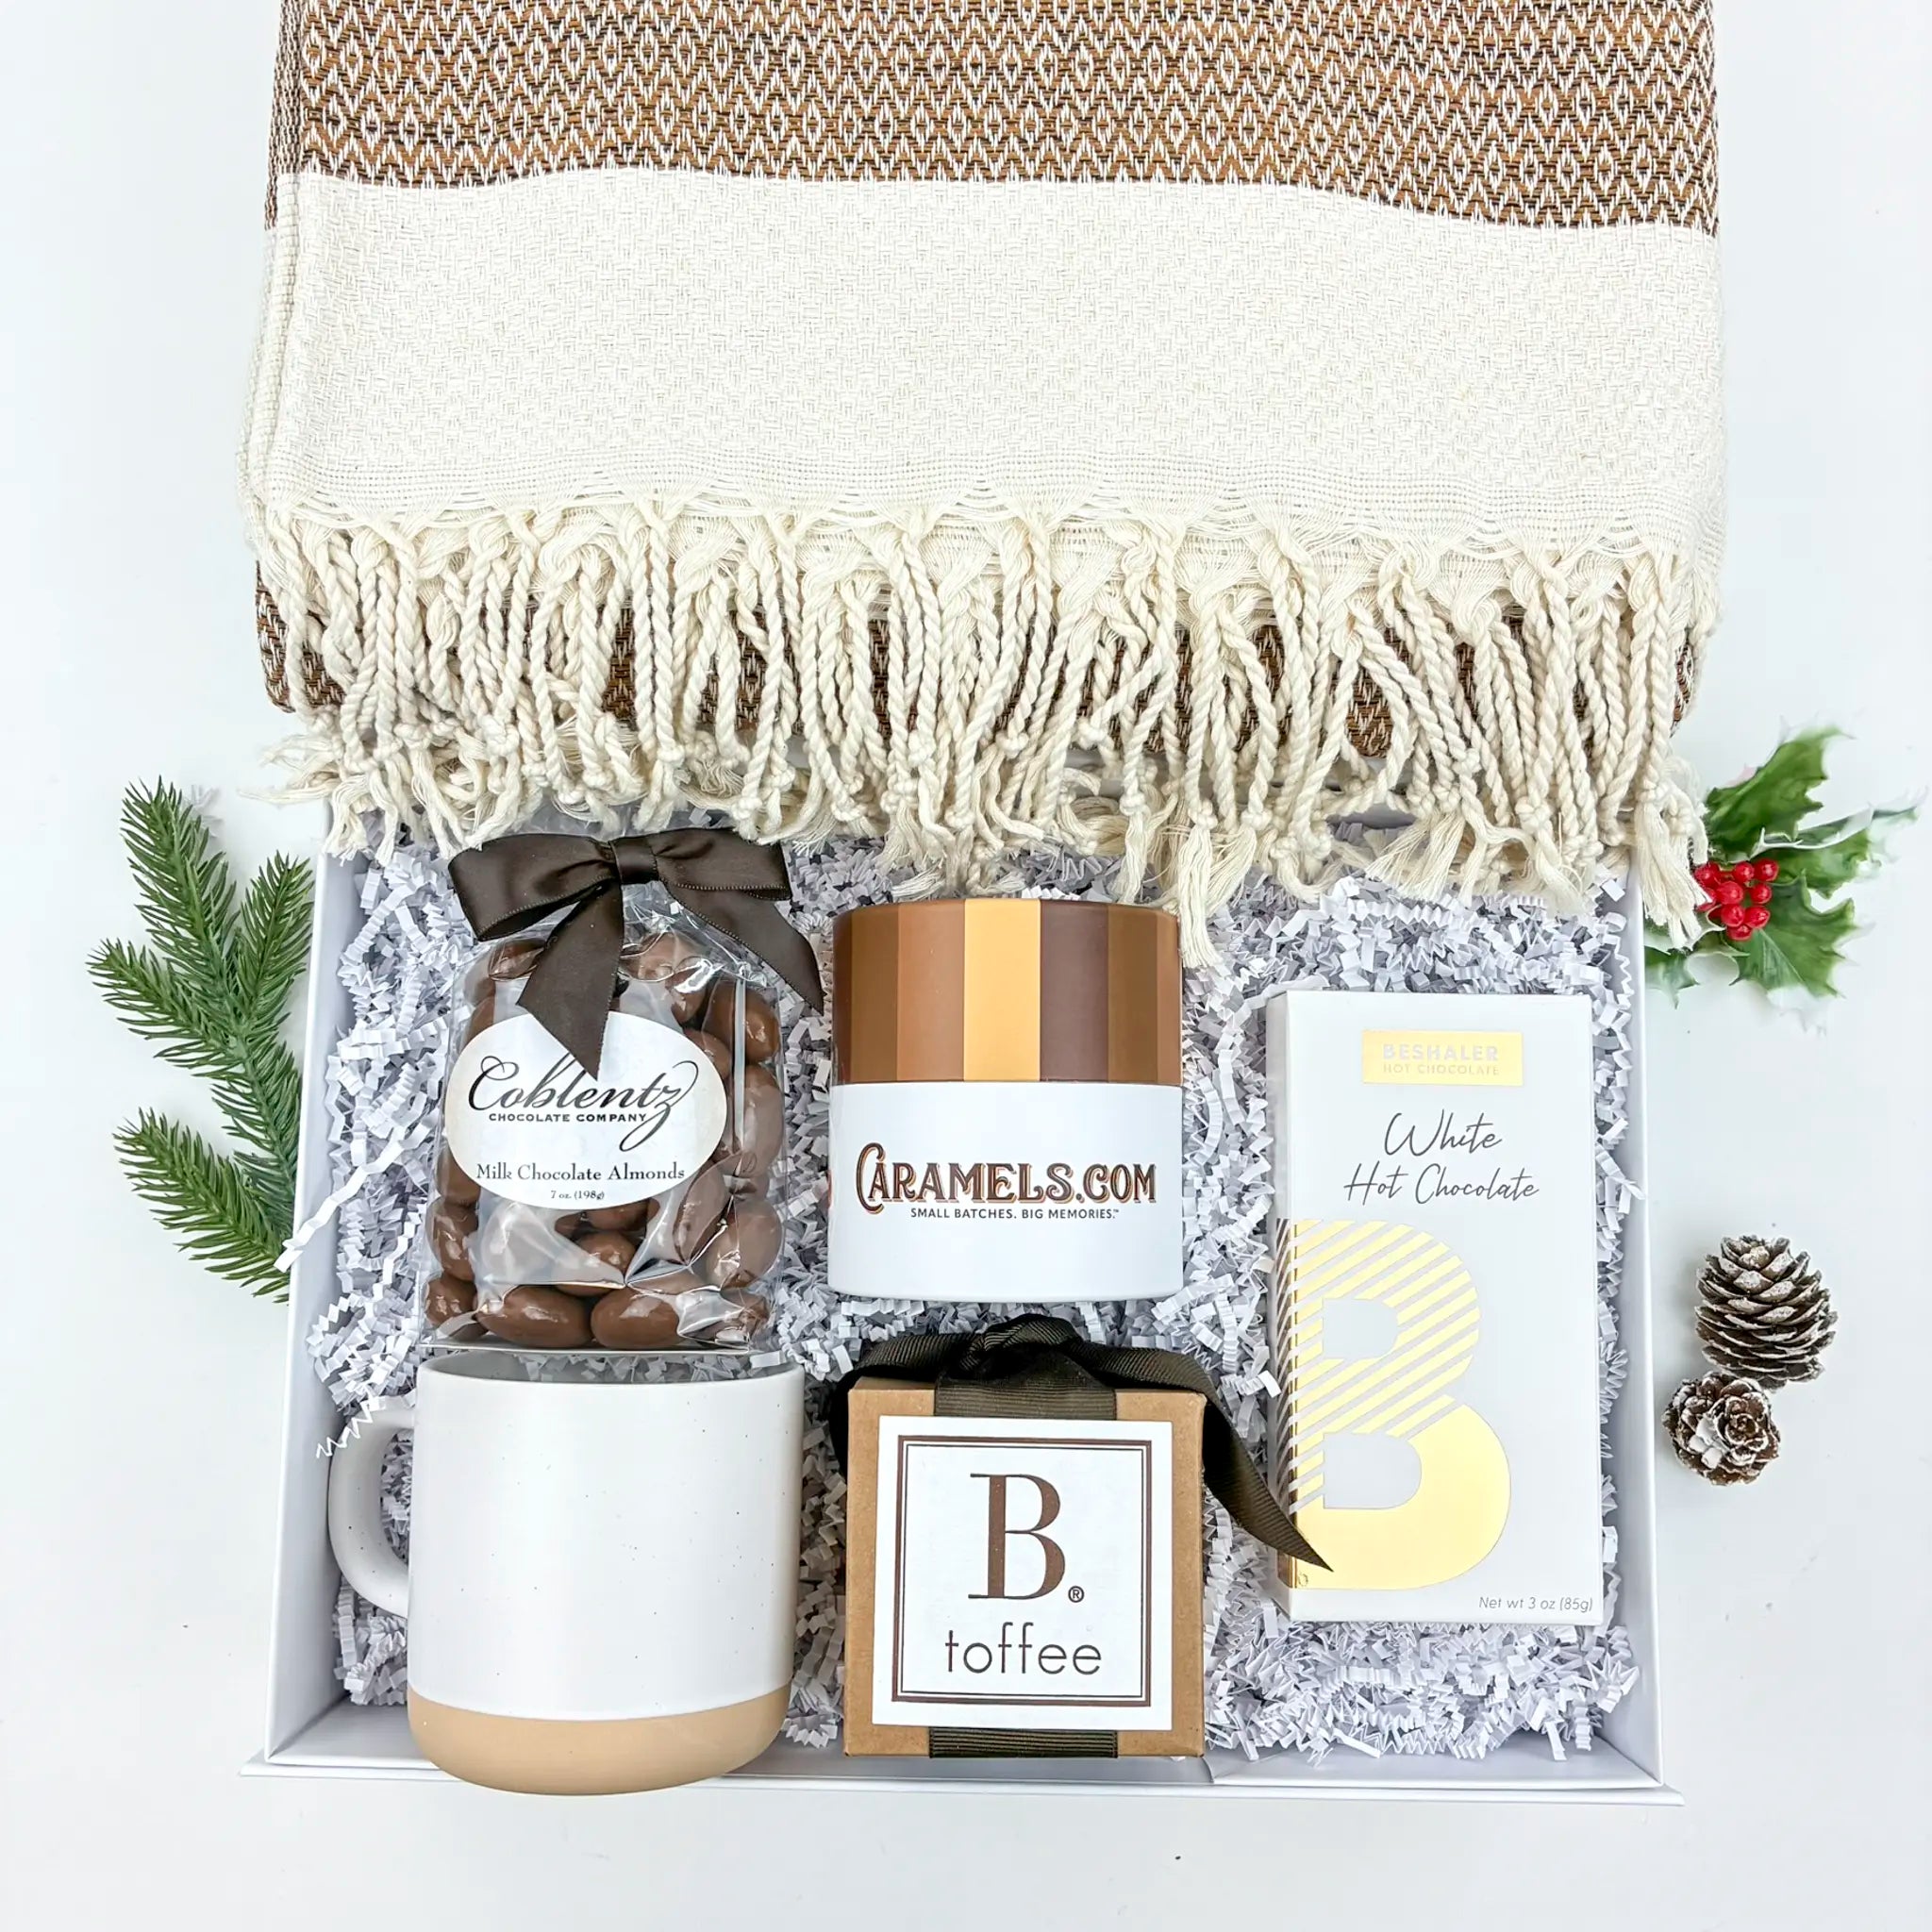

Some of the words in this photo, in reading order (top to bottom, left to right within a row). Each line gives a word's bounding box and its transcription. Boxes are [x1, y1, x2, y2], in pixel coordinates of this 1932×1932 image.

[1383, 1043, 1499, 1061] BESHALER
[1383, 1063, 1410, 1074] HOT
[1418, 1064, 1500, 1076] CHOCOLATE
[468, 1052, 699, 1152] Coblentz
[489, 1113, 570, 1123] CHOCOLATE
[575, 1112, 647, 1123] COMPANY
[1384, 1108, 1503, 1157] White
[476, 1162, 512, 1180] Milk
[517, 1162, 602, 1180] Chocolate
[608, 1161, 685, 1179] Almonds
[1343, 1161, 1408, 1206] Hot
[1415, 1163, 1540, 1204] Chocolate
[550, 1191, 557, 1200] 7
[574, 1190, 605, 1200] (198g)
[910, 1208, 950, 1219] SMALL
[955, 1208, 1017, 1220] BATCHES.
[1022, 1208, 1043, 1220] BIG
[1276, 1218, 1511, 1591] B
[1479, 1596, 1503, 1610] Net
[1507, 1597, 1525, 1610] wt
[1528, 1597, 1537, 1610] 3
[1539, 1601, 1556, 1611] oz
[1559, 1597, 1593, 1613] (85g)
[945, 1622, 1102, 1675] toffee
